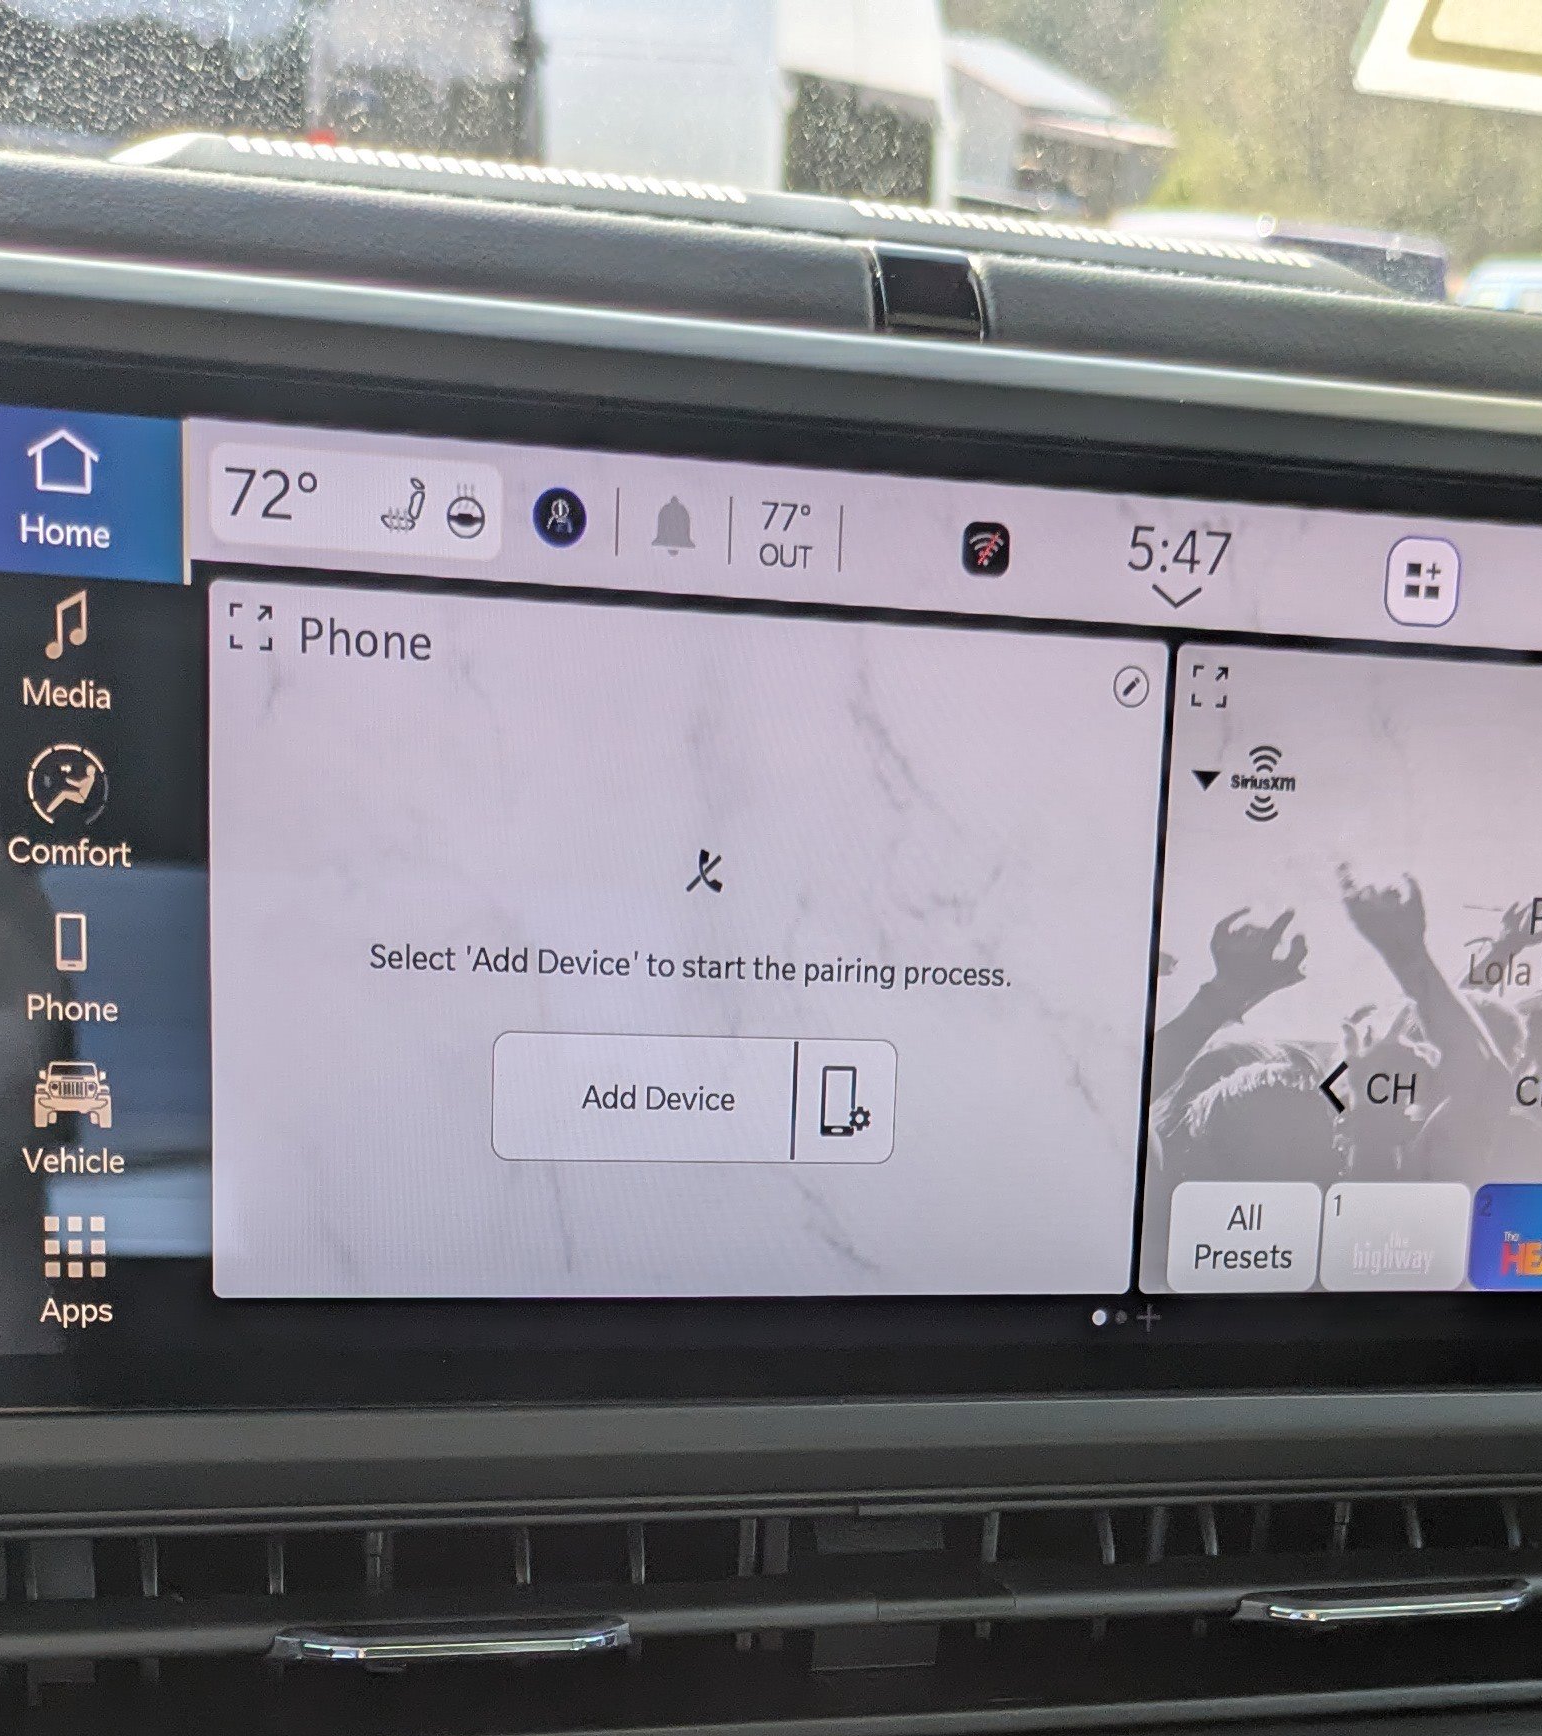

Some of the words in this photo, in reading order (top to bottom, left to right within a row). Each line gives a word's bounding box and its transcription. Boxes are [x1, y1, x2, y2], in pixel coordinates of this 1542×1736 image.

[224, 466, 318, 521] 72°
[19, 515, 110, 549] Home
[761, 502, 812, 533] 77°
[759, 543, 813, 570] OUT
[1126, 523, 1233, 576] 5:47
[301, 616, 432, 663] Phone
[23, 678, 111, 710] Media
[8, 837, 132, 869] Comfort
[369, 943, 456, 972] Select
[466, 945, 529, 975] 'Add
[537, 949, 639, 977] Device'
[646, 953, 675, 978] to
[682, 955, 746, 981] start
[753, 956, 797, 983] the
[803, 959, 896, 990] pairing
[903, 965, 1012, 990] process.
[1468, 954, 1531, 986] Lola
[26, 994, 118, 1023] Phone
[581, 1084, 637, 1111] Add
[645, 1087, 735, 1112] Device
[1366, 1072, 1418, 1107] CH
[22, 1148, 125, 1176] Vehicle
[1227, 1204, 1263, 1233] All
[1334, 1194, 1342, 1216] 1
[1193, 1242, 1293, 1271] Presets
[40, 1298, 113, 1328] Apps
